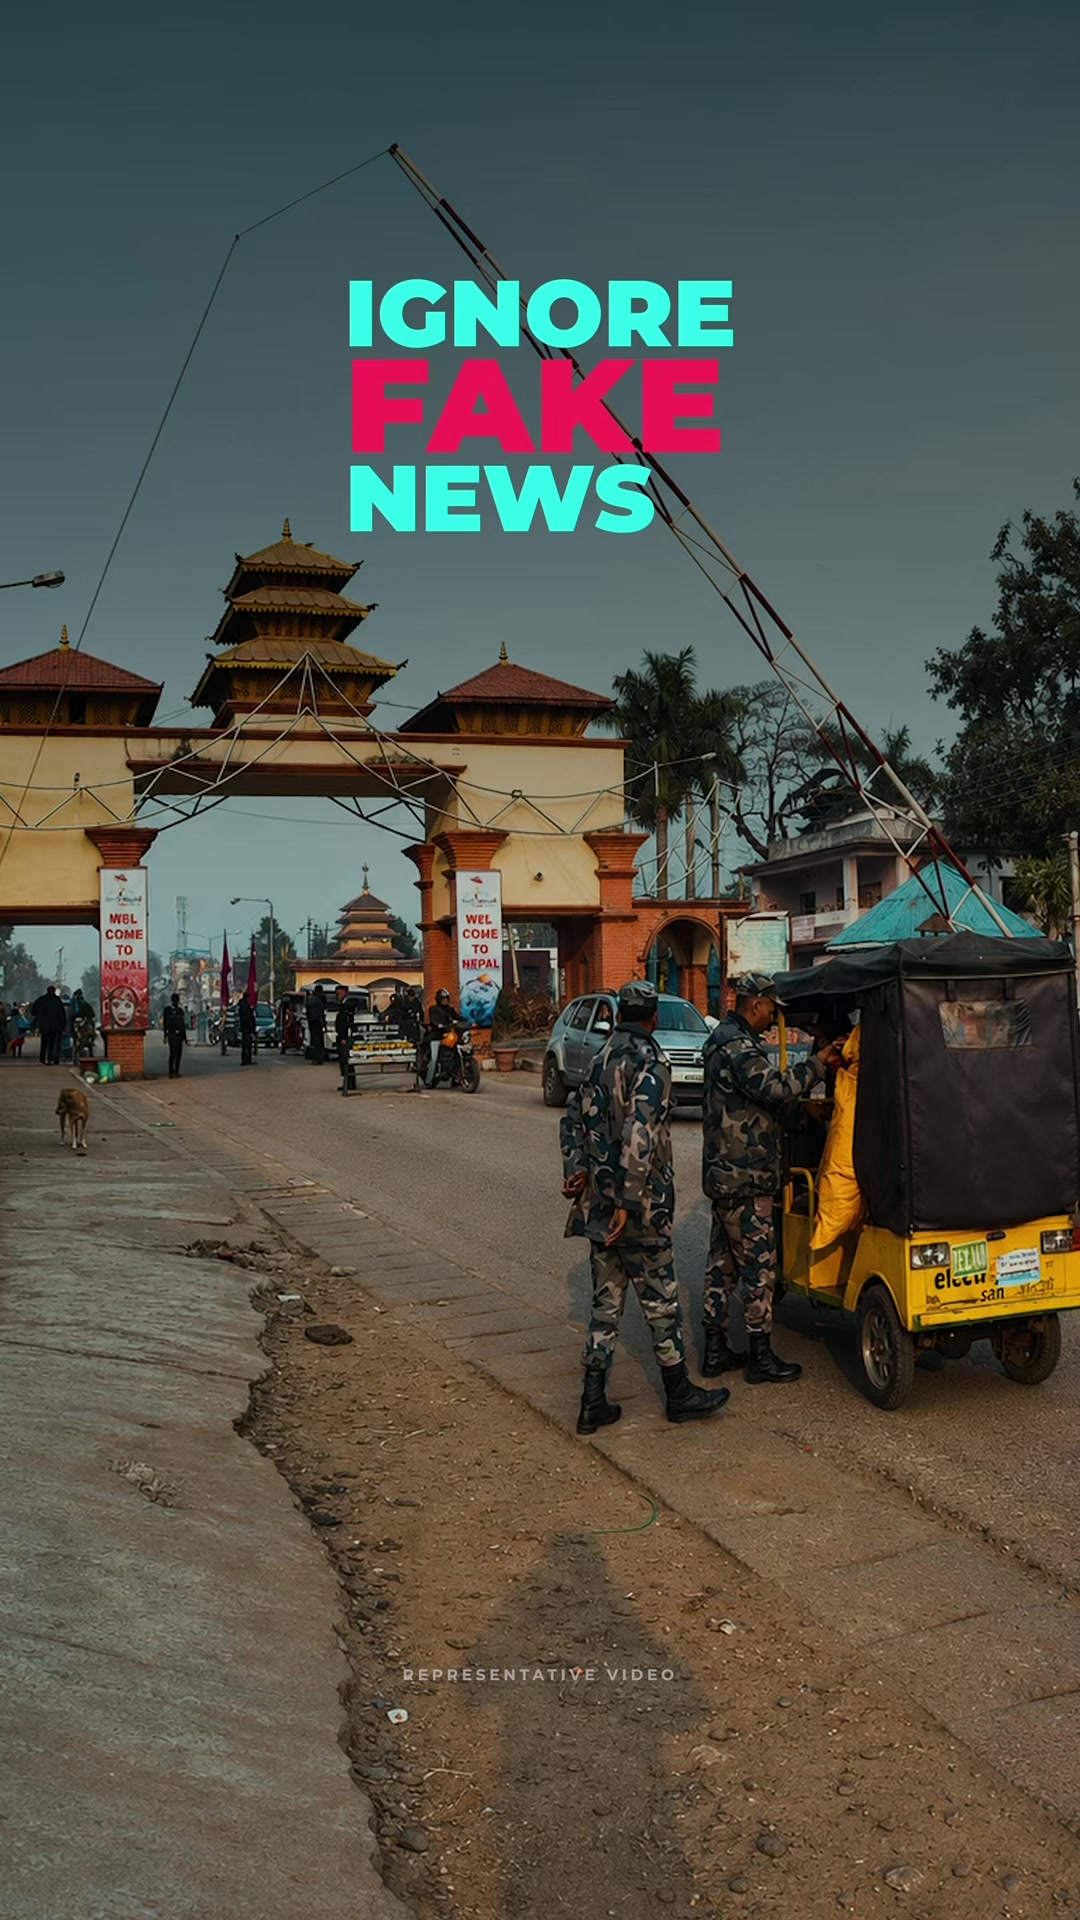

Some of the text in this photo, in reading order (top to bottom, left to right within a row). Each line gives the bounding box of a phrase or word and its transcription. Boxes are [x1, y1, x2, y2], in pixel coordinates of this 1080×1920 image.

[465, 914, 492, 925] WEL
[105, 928, 144, 940] COME
[462, 928, 499, 940] COME
[115, 944, 133, 956] TO
[471, 943, 489, 955] TO
[104, 960, 145, 970] NEPAL
[462, 959, 500, 970] NEPAL
[980, 1287, 1005, 1303] san
